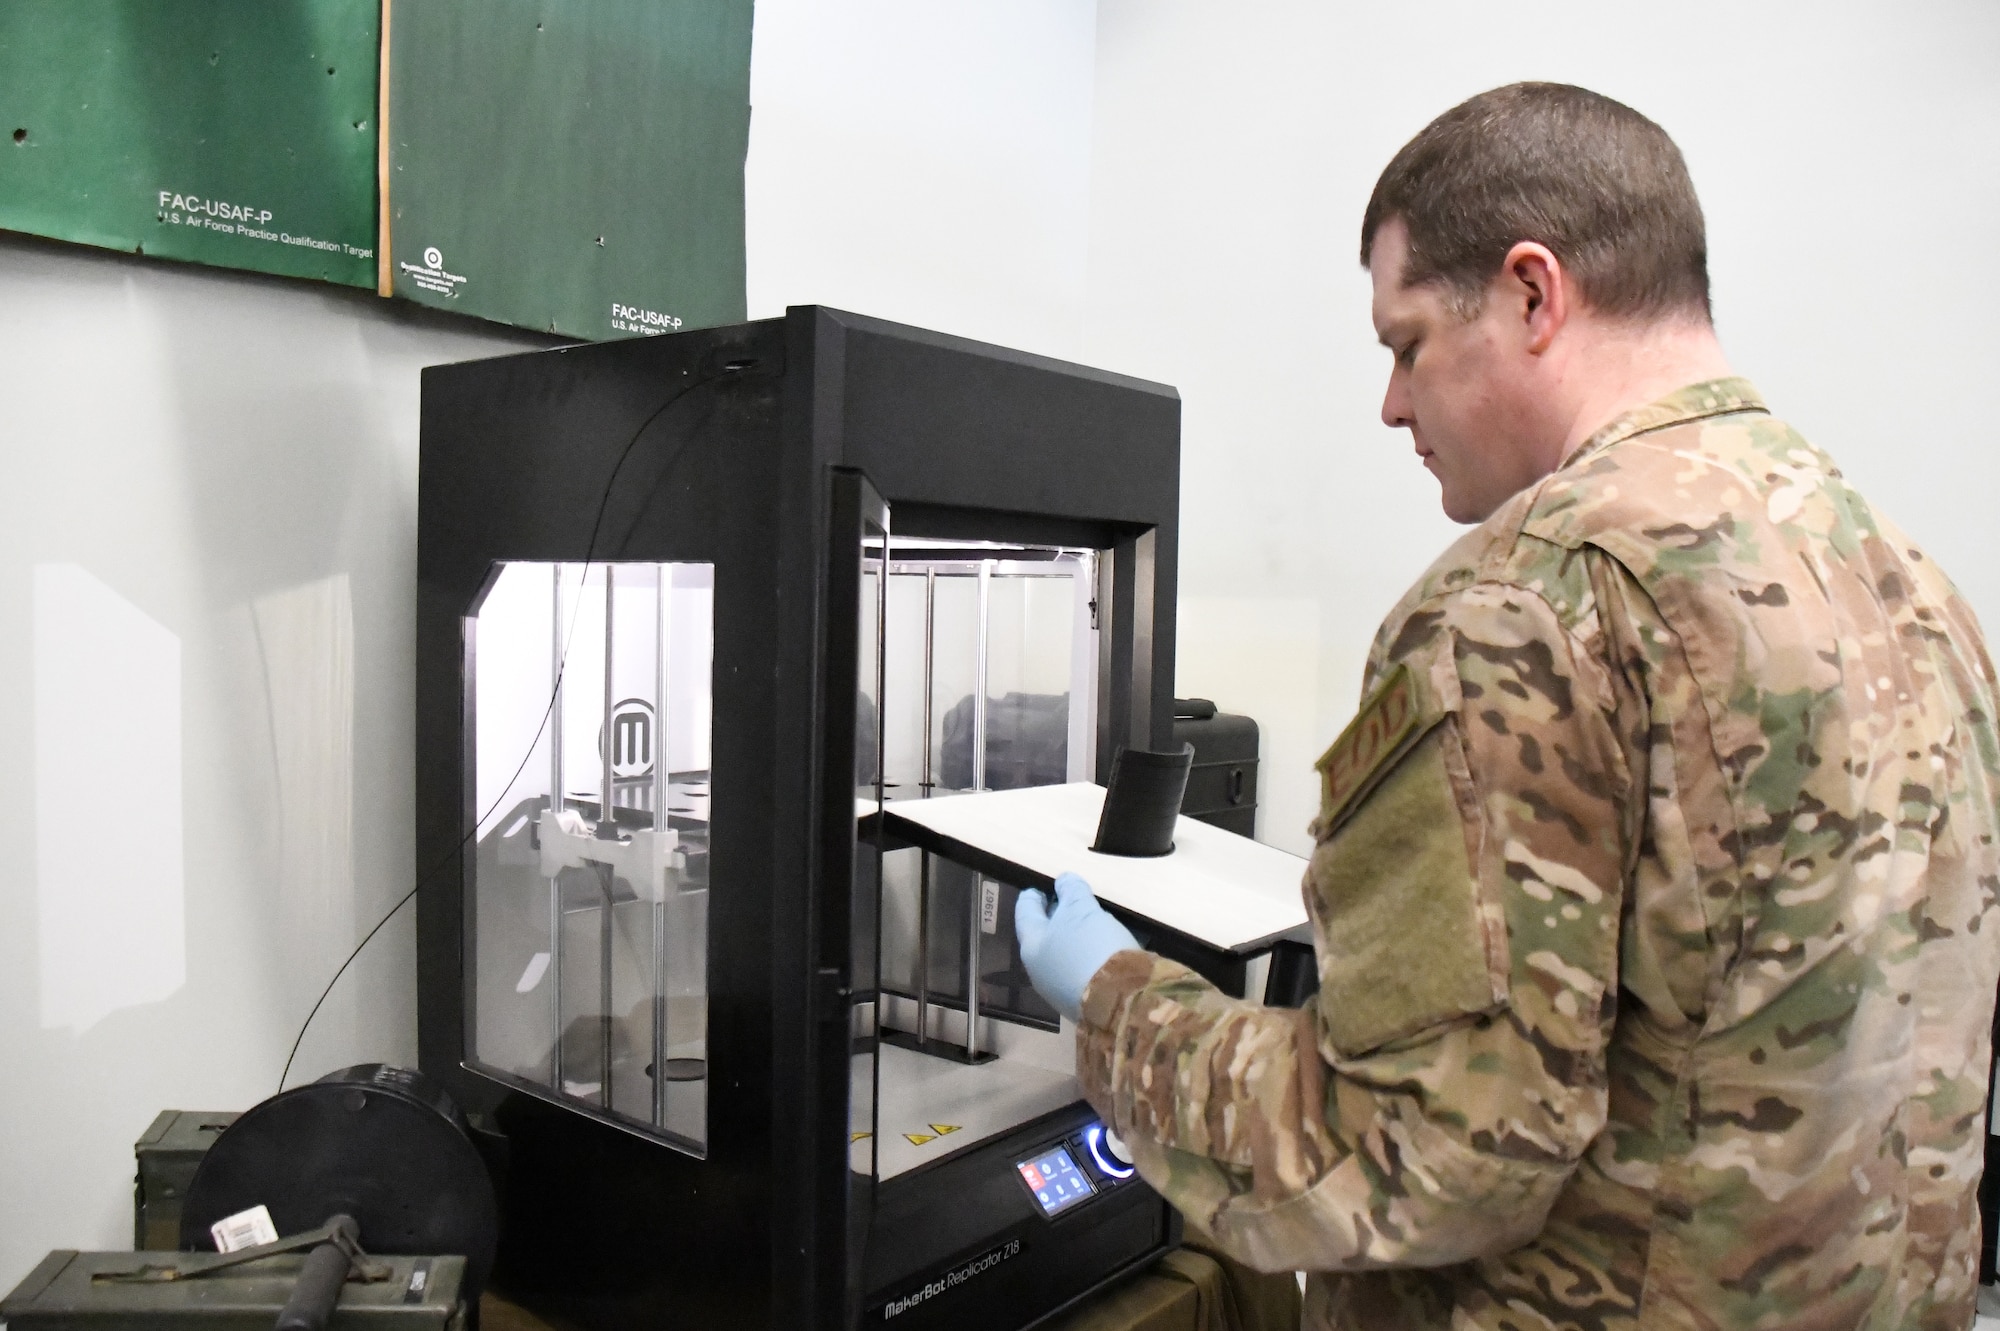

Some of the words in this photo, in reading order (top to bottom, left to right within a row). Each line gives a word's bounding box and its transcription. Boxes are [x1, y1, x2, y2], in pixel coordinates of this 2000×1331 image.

[159, 190, 273, 225] FAC-USAF-P
[186, 215, 202, 227] Air
[204, 218, 234, 234] Force
[237, 224, 279, 242] Practice
[280, 232, 341, 253] Qualification
[343, 243, 374, 259] Target
[442, 271, 467, 283] Targets
[611, 319, 628, 330] U.S.
[628, 323, 640, 332] Air
[612, 303, 683, 330] FAC-USAF-P
[1327, 685, 1408, 801] EOD
[984, 888, 995, 923] 13967
[884, 1279, 946, 1320] MakerBot
[947, 1250, 1003, 1288] Replicator
[1003, 1239, 1020, 1260] Z18
